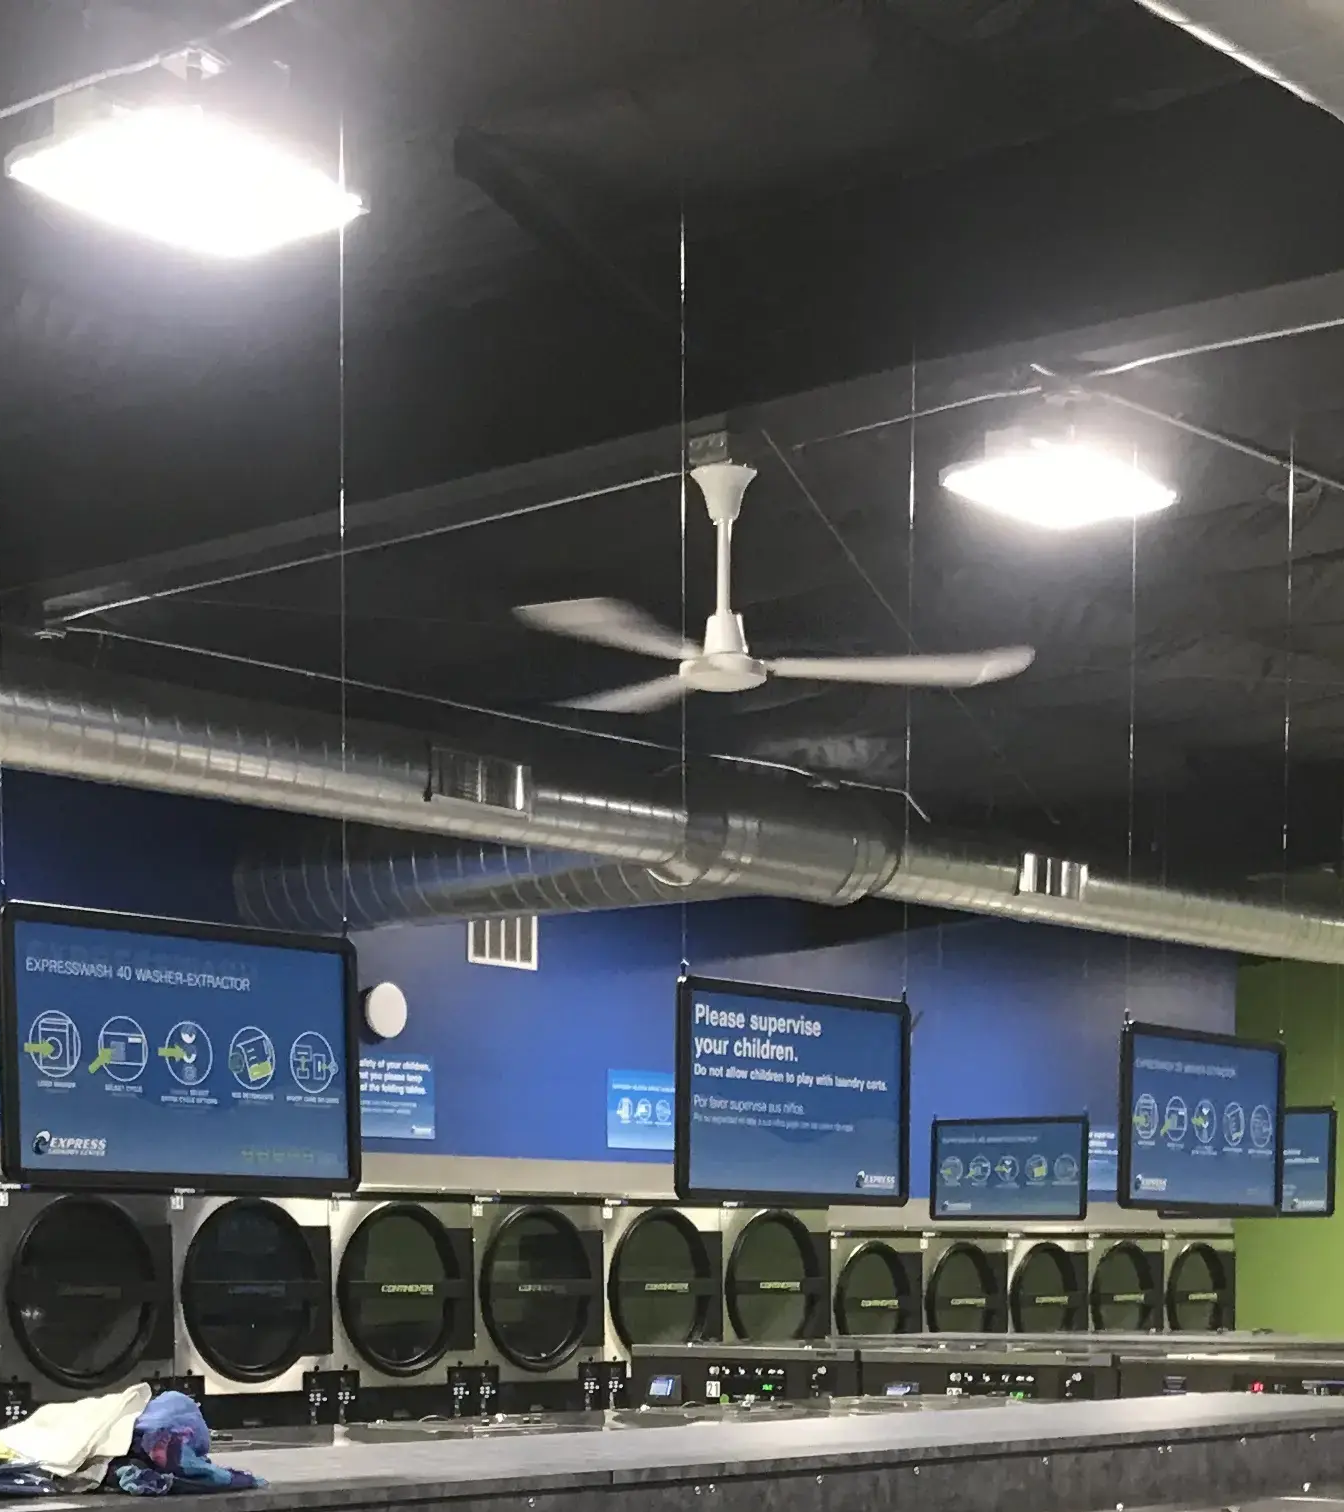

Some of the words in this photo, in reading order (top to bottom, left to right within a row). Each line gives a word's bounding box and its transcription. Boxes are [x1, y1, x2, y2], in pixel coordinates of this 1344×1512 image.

[25, 956, 113, 980] EXPRESSWASH
[116, 965, 131, 981] 40
[135, 968, 250, 992] WASHER-EXTRACTOR
[694, 1003, 745, 1029] Please
[750, 1014, 823, 1038] supervise
[694, 1036, 729, 1058] your
[733, 1037, 799, 1062] children.
[359, 1058, 376, 1069] afety
[693, 1063, 707, 1076] Do
[709, 1066, 724, 1078] not
[726, 1066, 748, 1080] allow
[750, 1068, 784, 1084] children
[786, 1071, 795, 1084] to
[797, 1072, 814, 1088] play
[816, 1073, 834, 1087] with
[835, 1076, 865, 1093] laundry
[49, 1137, 107, 1150] EXPRESS
[707, 1382, 719, 1397] 21
